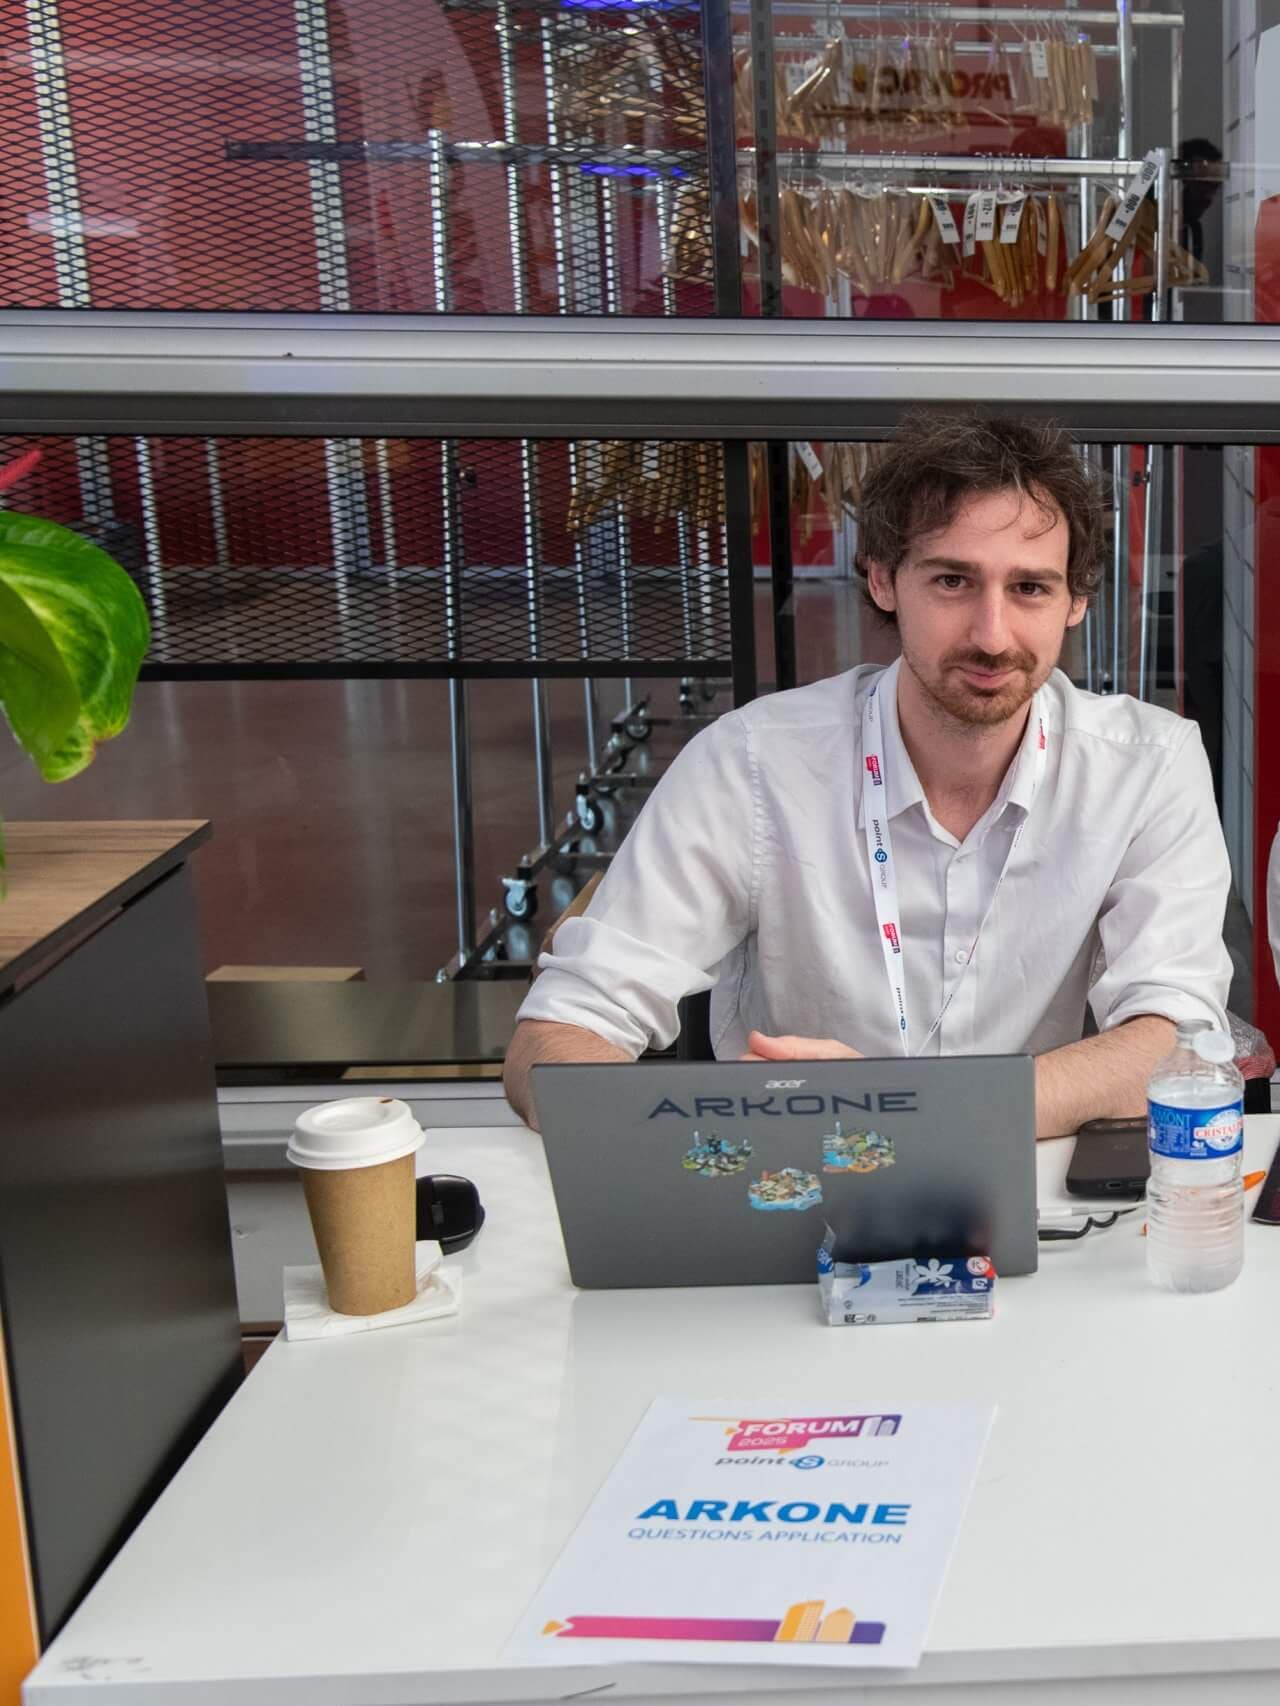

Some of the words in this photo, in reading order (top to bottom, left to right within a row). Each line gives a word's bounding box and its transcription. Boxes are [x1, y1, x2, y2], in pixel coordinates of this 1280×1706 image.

[872, 819, 884, 847] point
[764, 1079, 807, 1089] acer
[648, 1091, 918, 1119] ARKONE
[743, 1420, 859, 1436] FORUM
[737, 1436, 789, 1447] 2025
[715, 1456, 787, 1466] point
[827, 1458, 890, 1467] GROUP
[635, 1499, 912, 1525] ARKONE
[627, 1527, 752, 1541] QUESTIONS
[758, 1530, 903, 1544] APPLICATION
